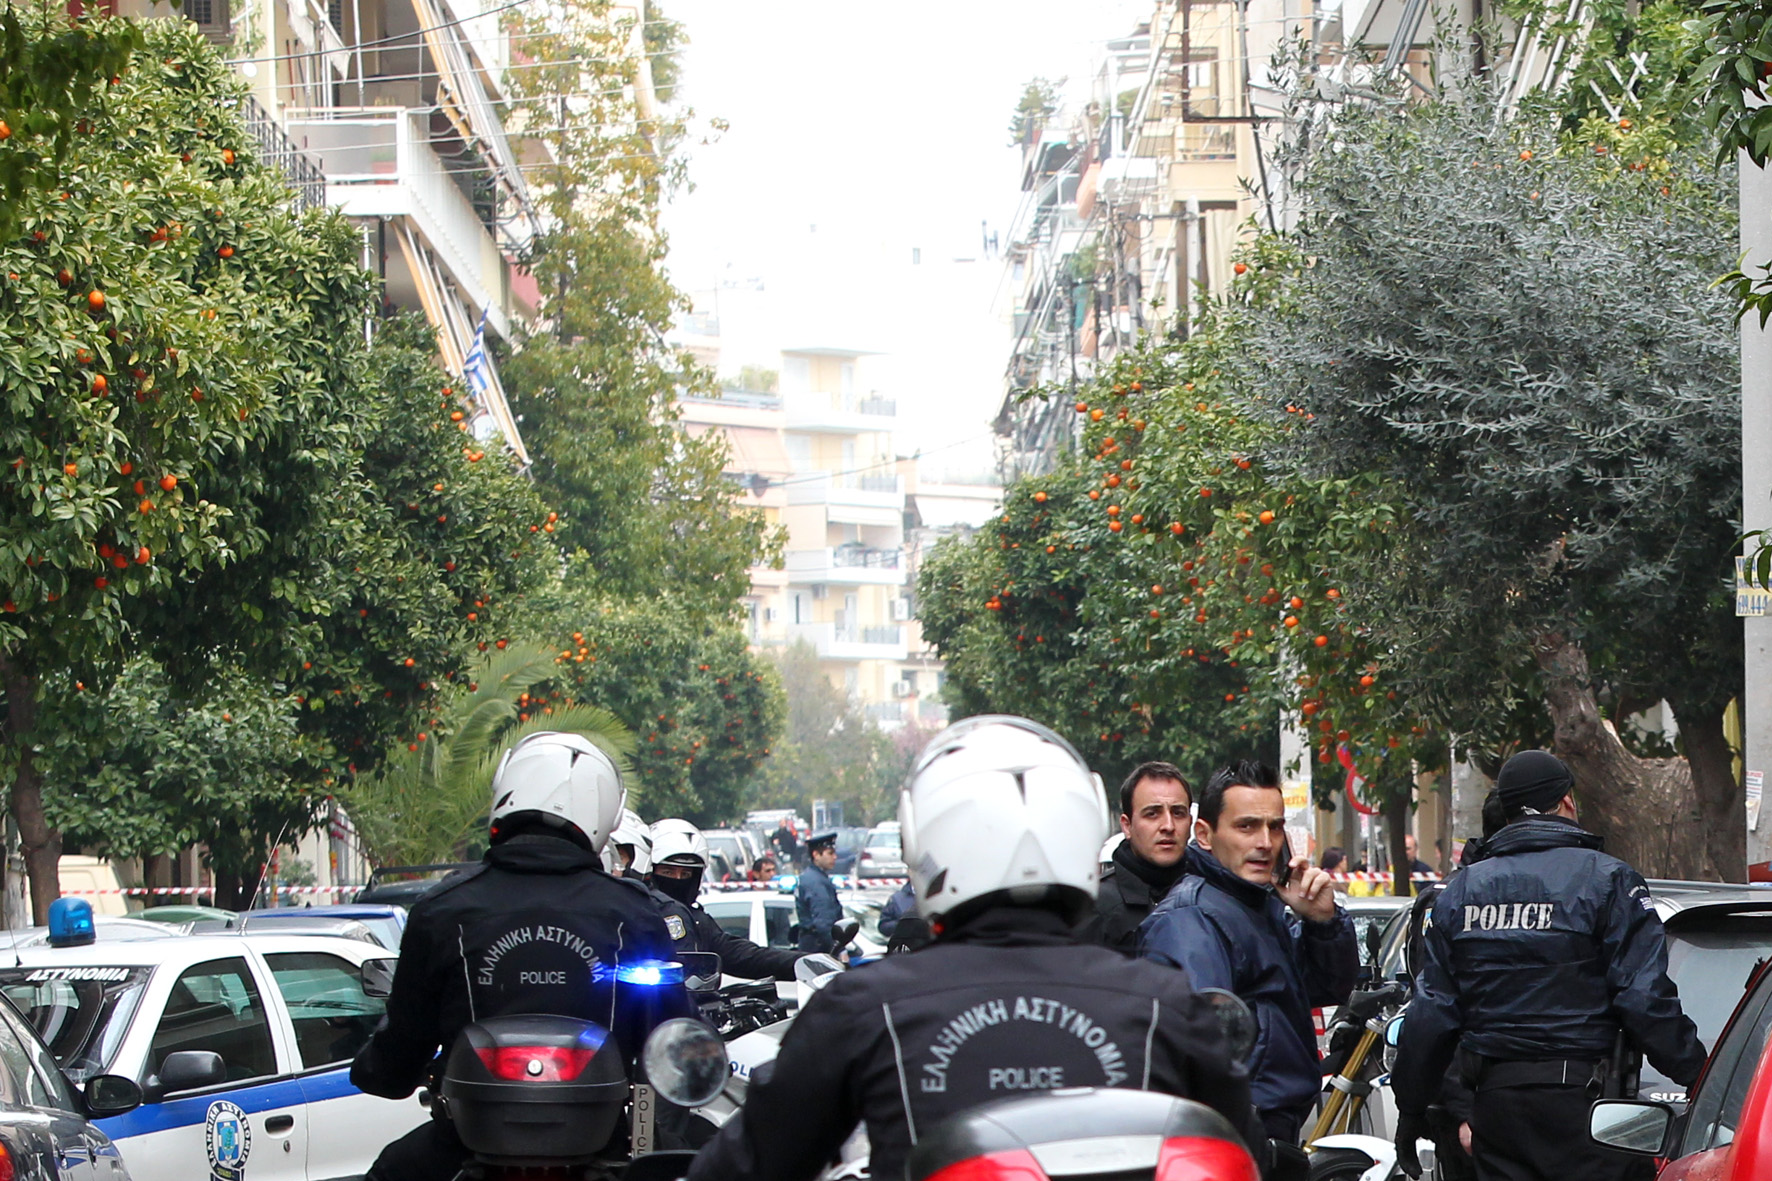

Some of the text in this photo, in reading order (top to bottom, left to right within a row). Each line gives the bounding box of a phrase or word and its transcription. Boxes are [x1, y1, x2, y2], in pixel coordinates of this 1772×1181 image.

[1463, 902, 1554, 932] POLICE
[478, 925, 605, 985] ΕΛΛΗΝΙΚΗ ΑΣΤΥΝΟΜΙΑ
[25, 968, 130, 981] ΑΣΤΥΝΟΜΙΑ
[520, 971, 566, 984] POLICE
[920, 996, 1129, 1093] ΕΛΛΗΝΙΚΗ ΑΣΤΥΝΟΜΙΑ
[988, 1066, 1065, 1090] POLICE
[1650, 1092, 1690, 1103] SUZ
